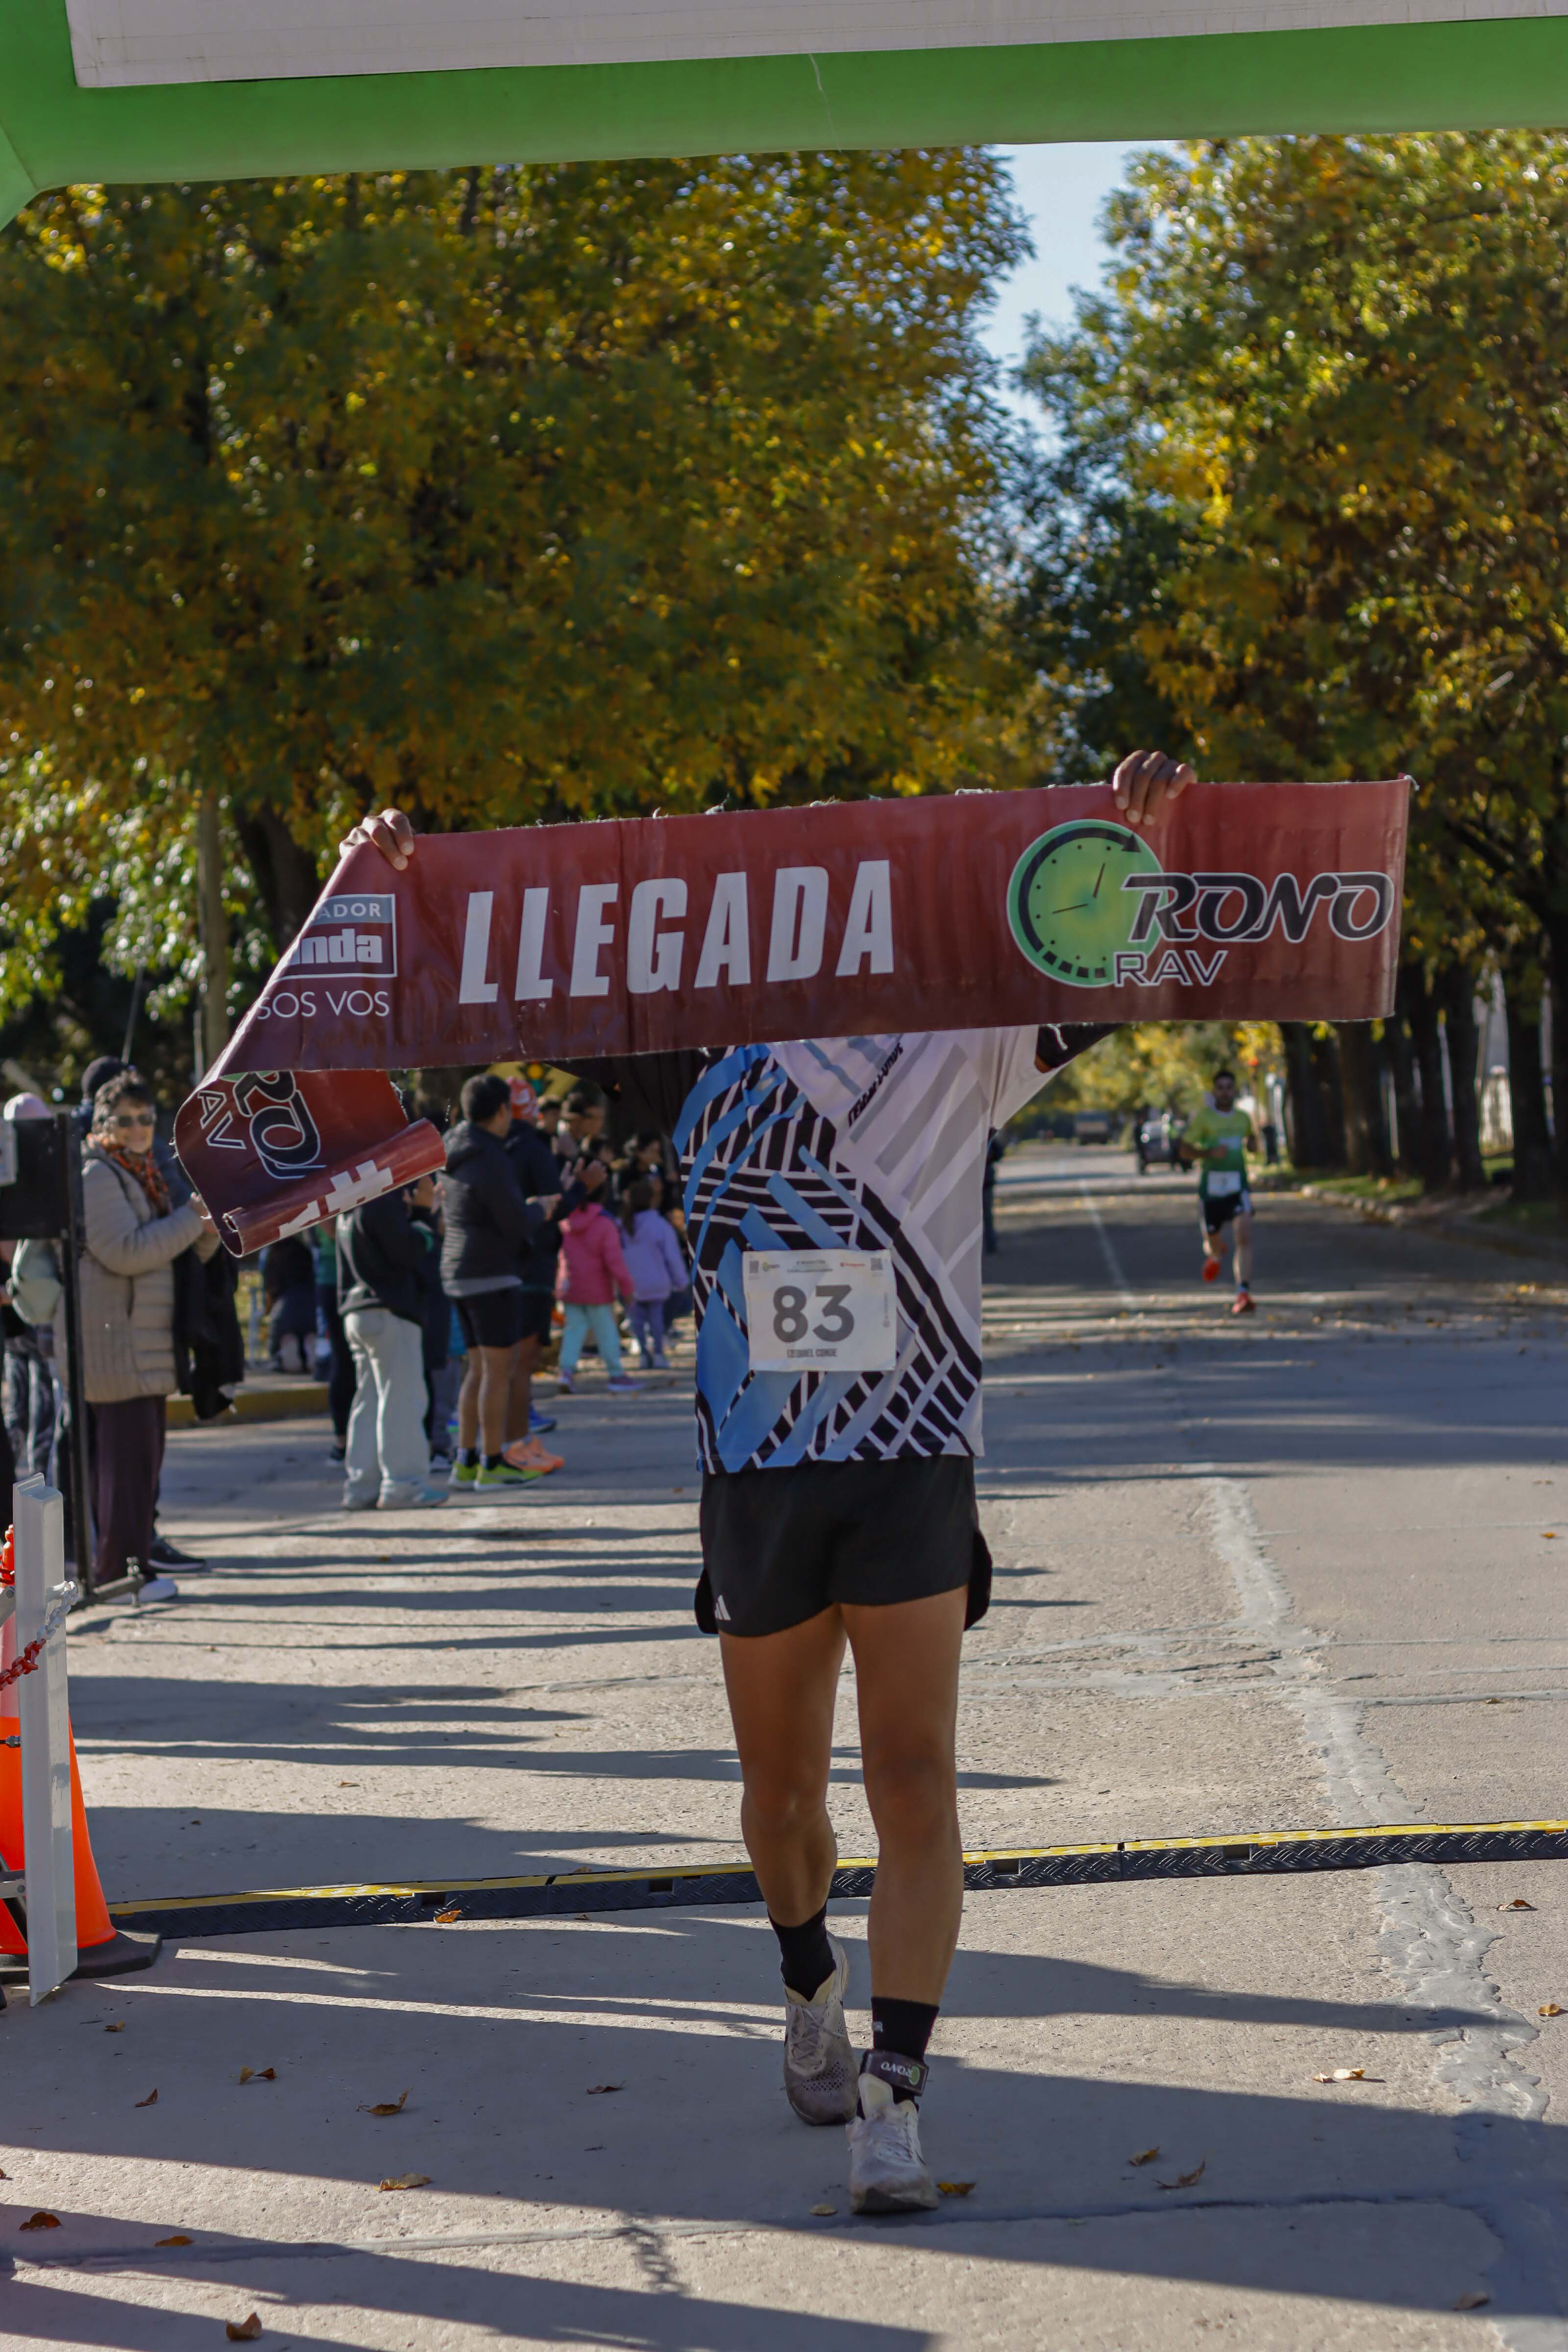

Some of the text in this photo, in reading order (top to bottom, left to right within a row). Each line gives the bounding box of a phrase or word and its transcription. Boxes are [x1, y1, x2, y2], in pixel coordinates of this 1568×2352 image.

[458, 859, 895, 1004] LLEGADA
[1114, 949, 1228, 988] RAV
[257, 989, 390, 1020] SOS VOS
[772, 1284, 855, 1343] 83
